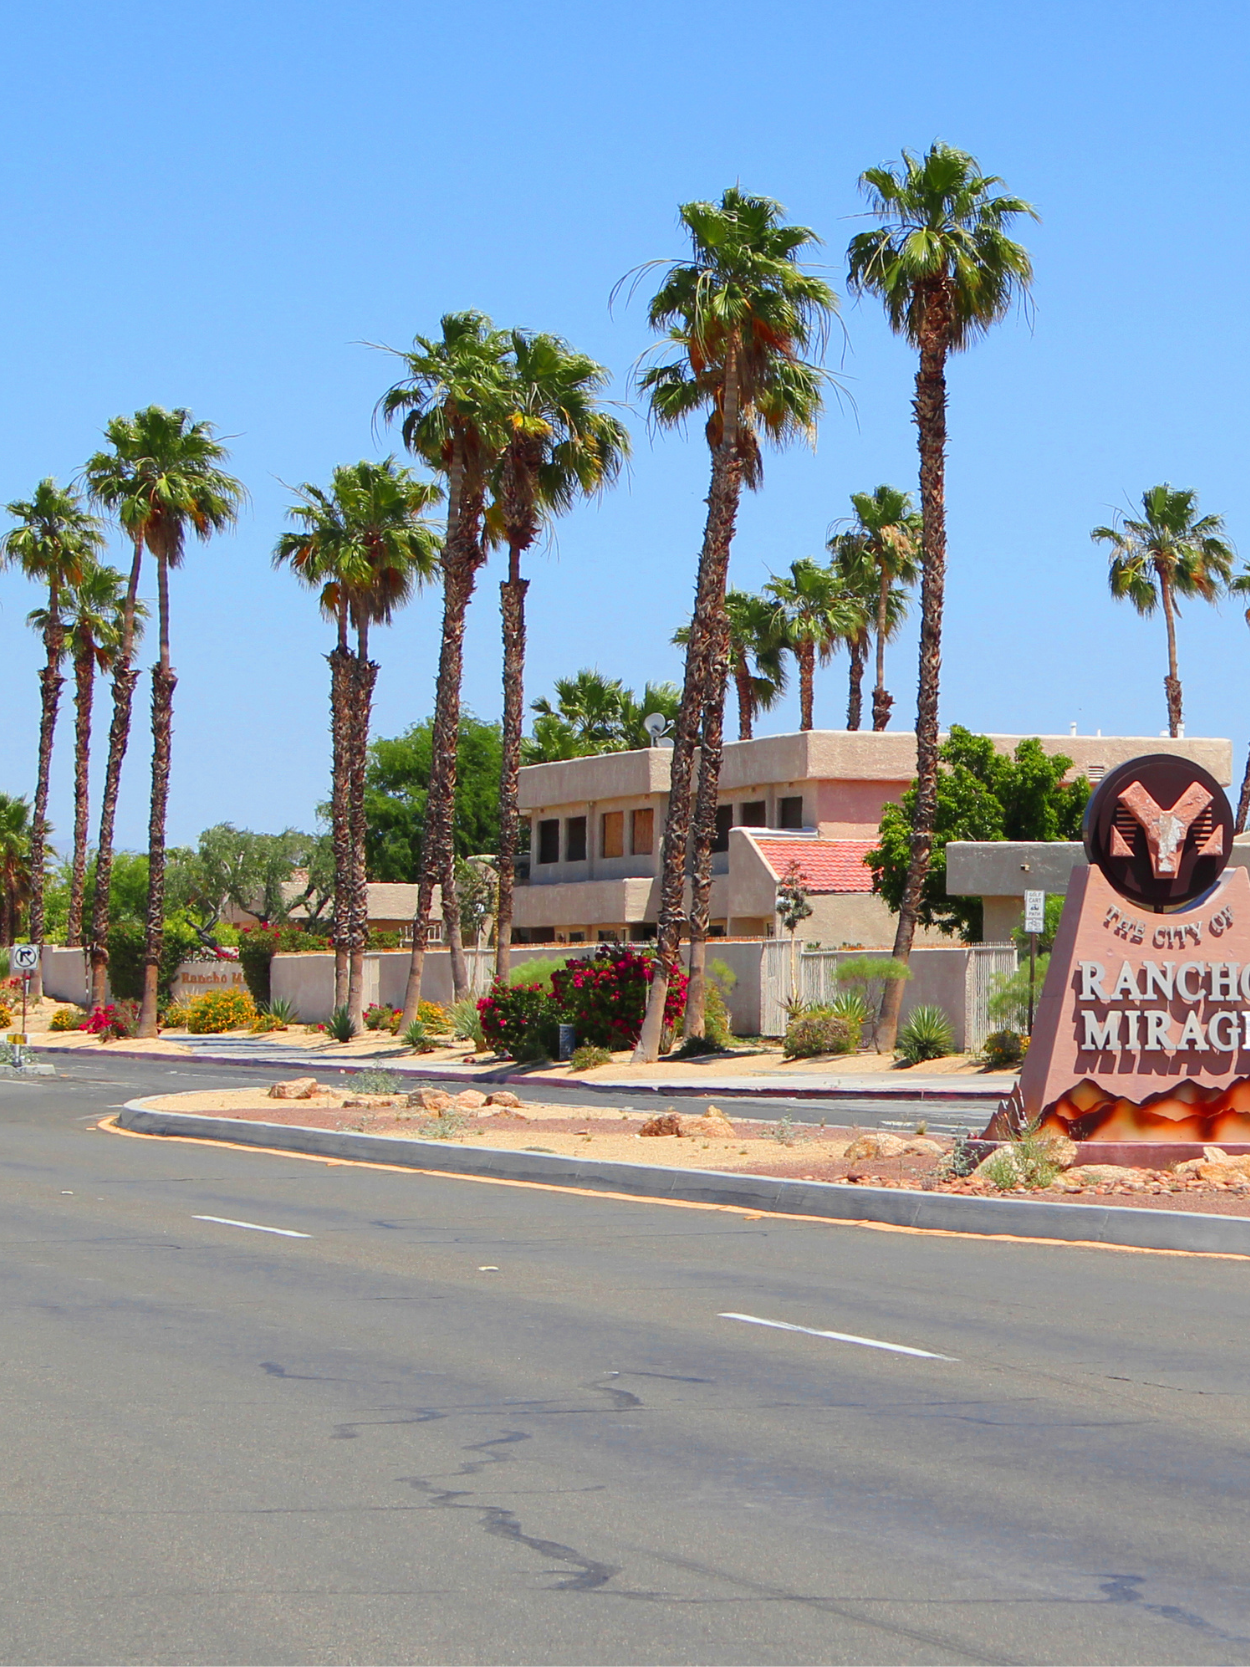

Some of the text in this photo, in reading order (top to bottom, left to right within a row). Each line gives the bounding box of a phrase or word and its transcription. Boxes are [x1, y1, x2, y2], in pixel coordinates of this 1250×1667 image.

[1104, 903, 1236, 943] THE CITY OF
[181, 971, 228, 984] Rancho
